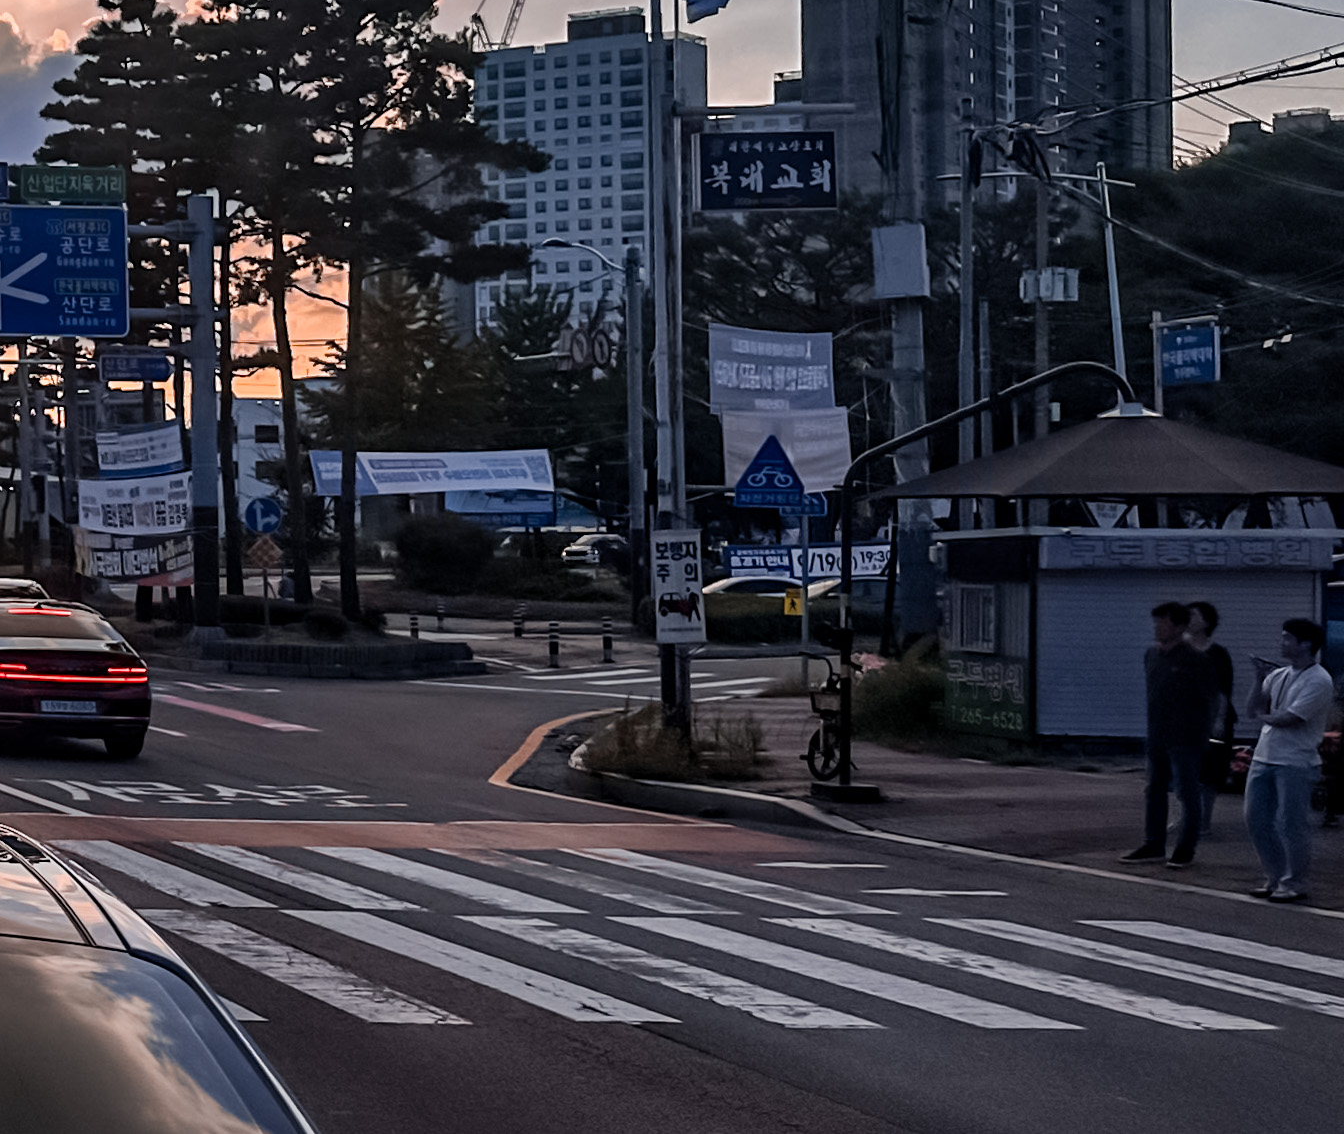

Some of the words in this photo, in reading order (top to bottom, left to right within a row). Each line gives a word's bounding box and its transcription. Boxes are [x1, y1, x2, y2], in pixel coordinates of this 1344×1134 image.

[27, 174, 122, 195] 산업단지육거리
[59, 236, 112, 255] 공단로
[62, 297, 113, 314] 산단로
[58, 315, 117, 327] Sandan-ro
[656, 541, 698, 561] 보행자
[13, 777, 408, 808] 가로수로
